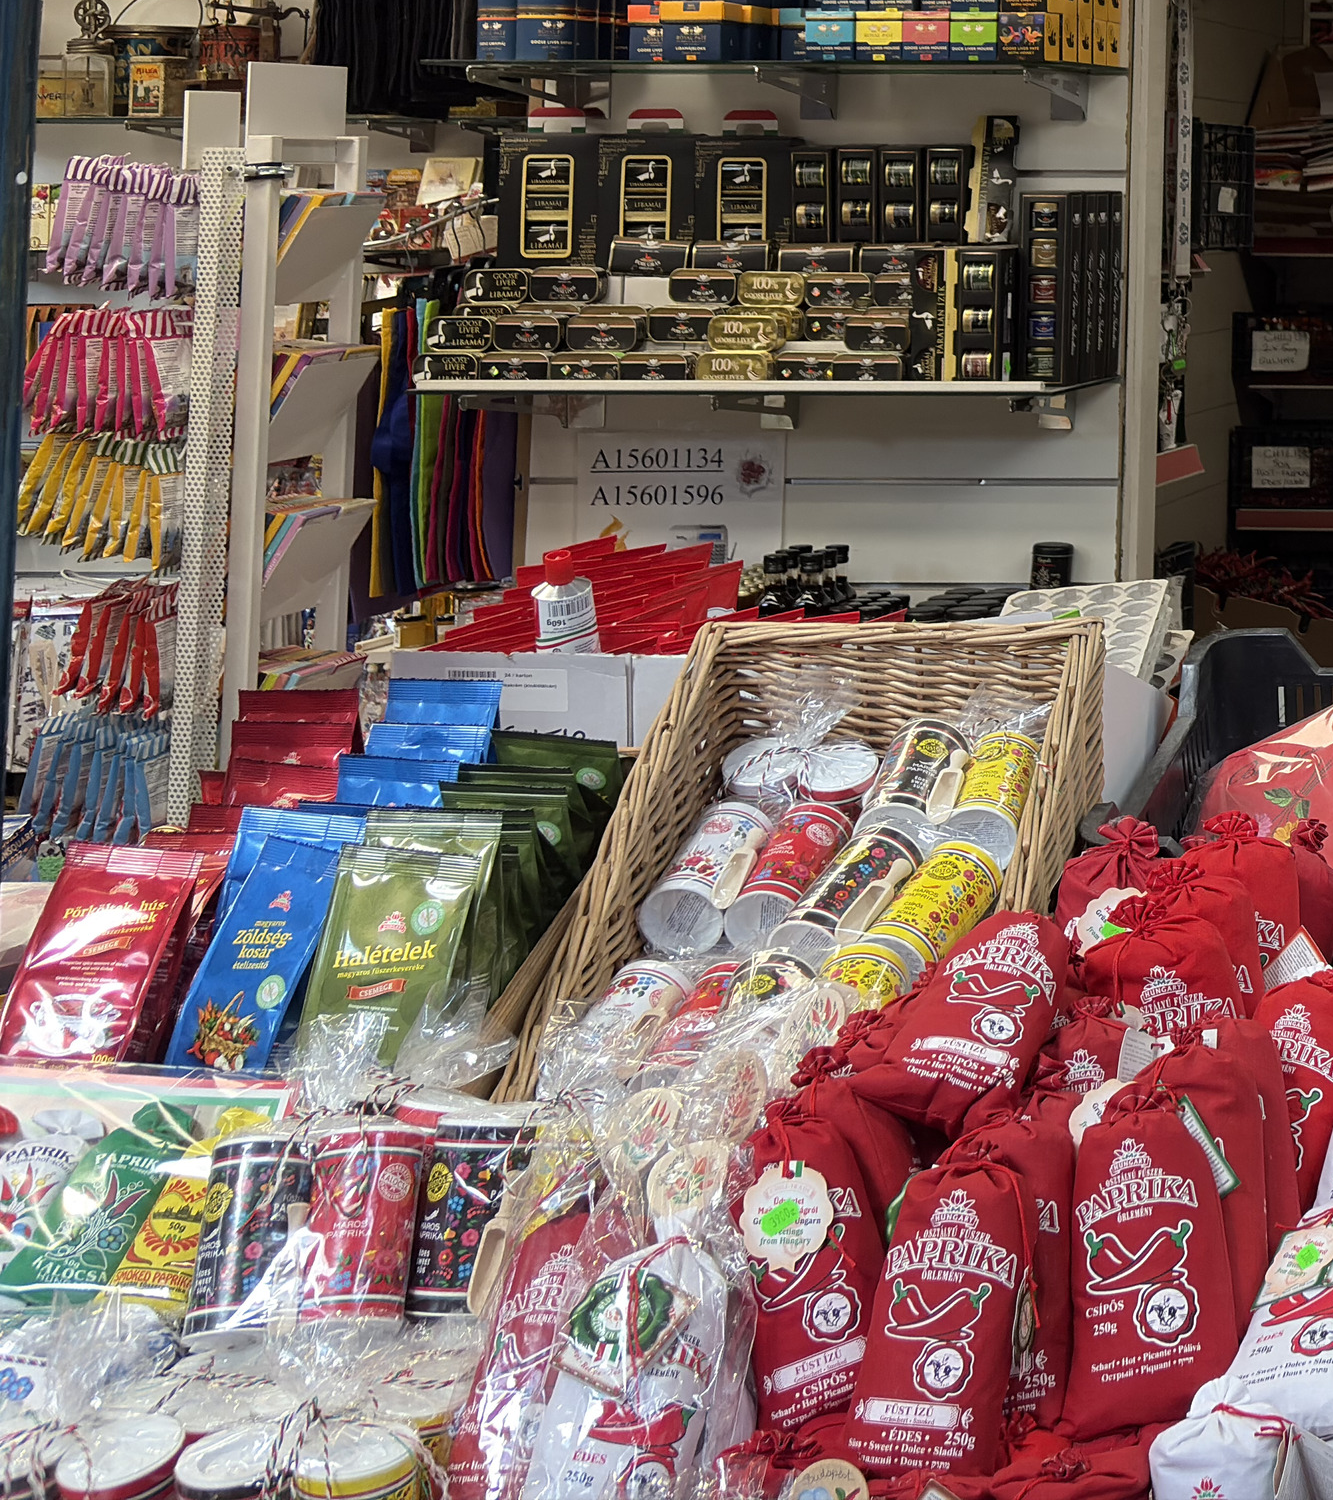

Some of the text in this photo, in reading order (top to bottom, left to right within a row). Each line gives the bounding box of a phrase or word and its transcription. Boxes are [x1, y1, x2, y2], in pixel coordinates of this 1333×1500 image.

[493, 272, 519, 280] GOOSE
[496, 279, 517, 287] LIVER
[751, 278, 779, 290] 100%
[456, 320, 483, 328] GOOSE
[459, 326, 480, 334] LIVER
[591, 447, 724, 471] A15601134
[591, 485, 724, 507] A15601596
[232, 927, 293, 953] Zöldség-
[238, 943, 276, 960] kosár
[333, 940, 435, 969] Halételek
[943, 938, 1055, 1005] PAPRIKA
[358, 982, 396, 997] CSEMEGE
[1077, 1174, 1198, 1229] PAPRIKA
[1117, 1207, 1153, 1222] ŐRLEMÉNY
[166, 1222, 187, 1233] 50g
[332, 1220, 367, 1232] MAROS
[885, 1237, 1017, 1287] PAPRIKA
[115, 1271, 150, 1283] SMOKED
[921, 1270, 964, 1284] ŐRLEMÉNY
[1086, 1300, 1124, 1318] CSÍPŐS
[1093, 1323, 1117, 1337] 250g
[1122, 1356, 1136, 1367] Hot
[888, 1429, 922, 1443] ÉDES
[945, 1432, 976, 1450] 250g
[572, 1450, 607, 1466] ÉDES
[564, 1472, 593, 1487] 250g
